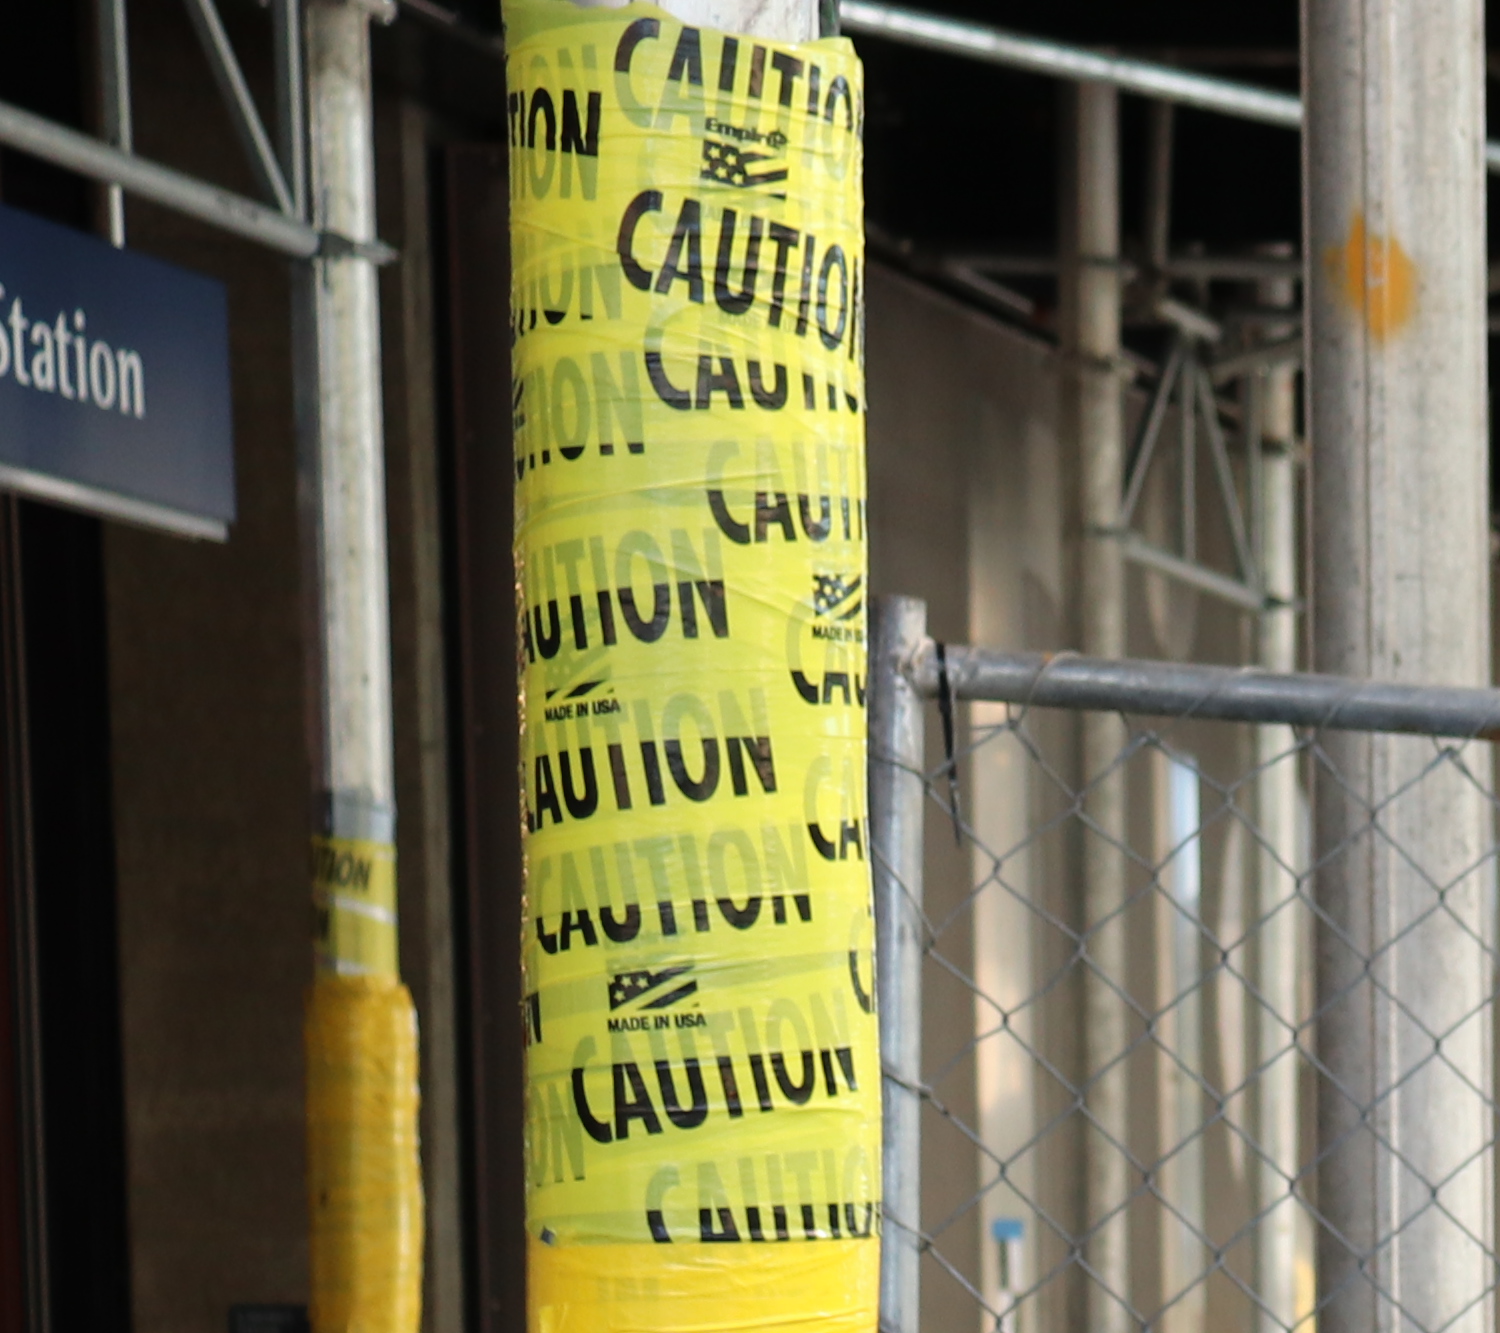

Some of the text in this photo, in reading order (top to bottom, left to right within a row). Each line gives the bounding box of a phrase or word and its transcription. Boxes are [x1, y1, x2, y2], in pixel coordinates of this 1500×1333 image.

[545, 698, 621, 723] MADE IN USA
[607, 1012, 707, 1034] MADE IN USA
[571, 990, 858, 1143] CAUTION
